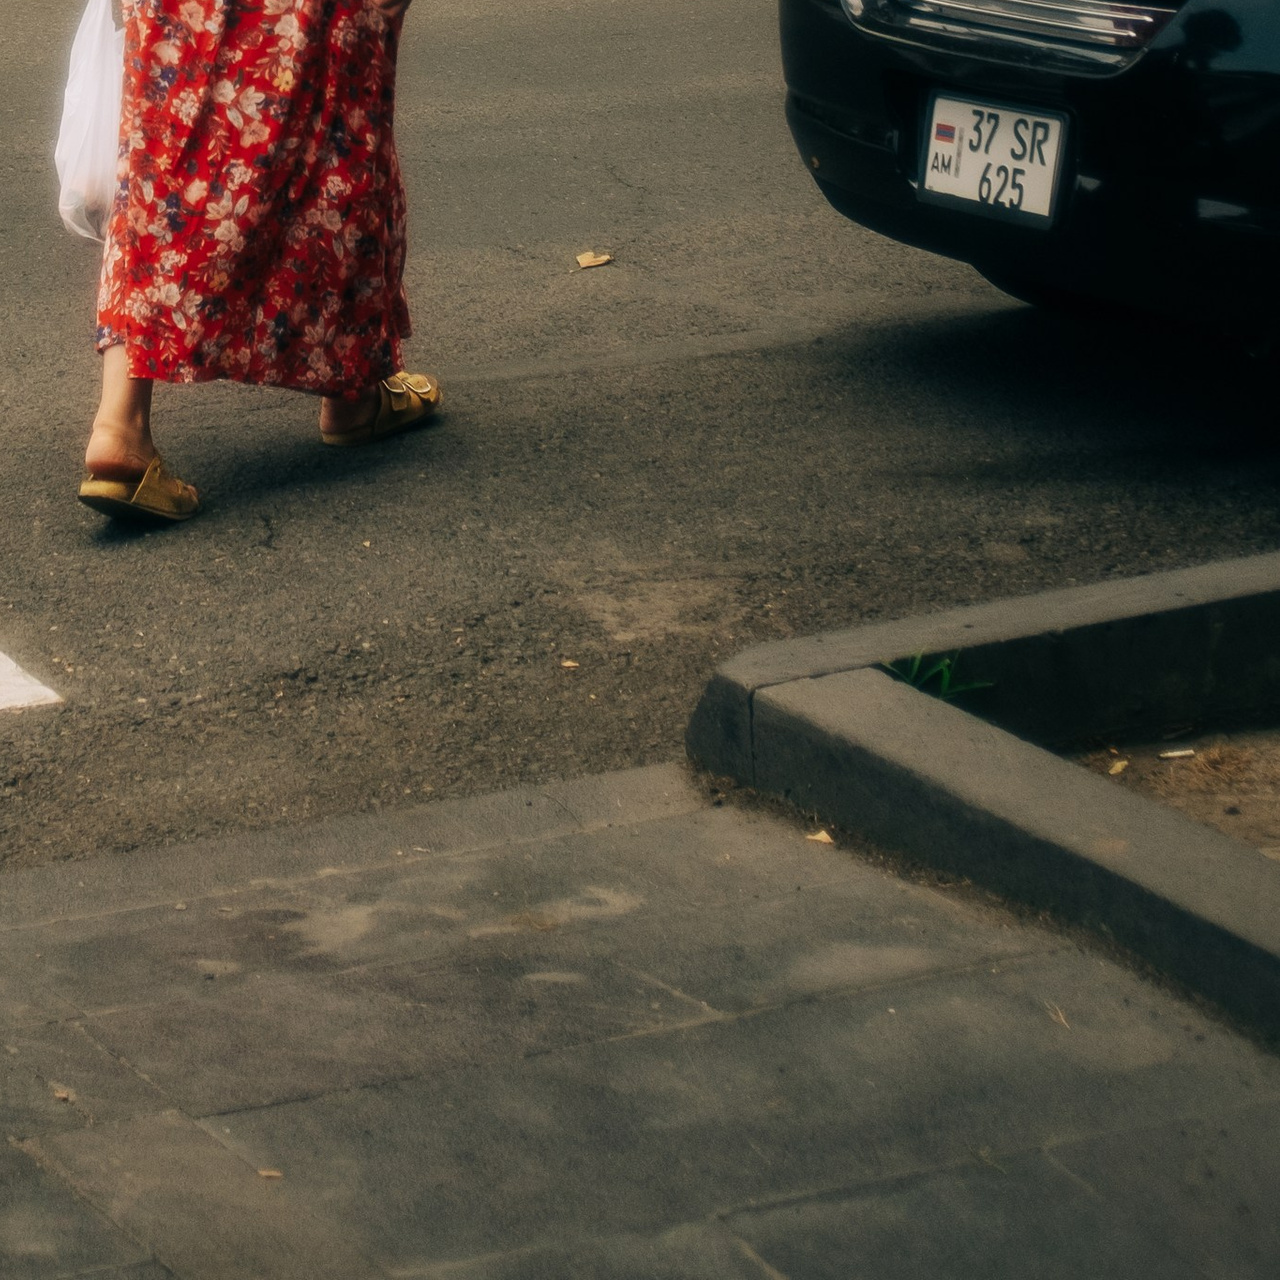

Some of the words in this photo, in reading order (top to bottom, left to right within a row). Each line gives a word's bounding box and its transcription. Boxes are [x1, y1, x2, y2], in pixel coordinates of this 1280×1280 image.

[969, 109, 1000, 155] 37
[1010, 118, 1050, 167] SR
[931, 152, 952, 176] AM
[978, 162, 1026, 208] 625
